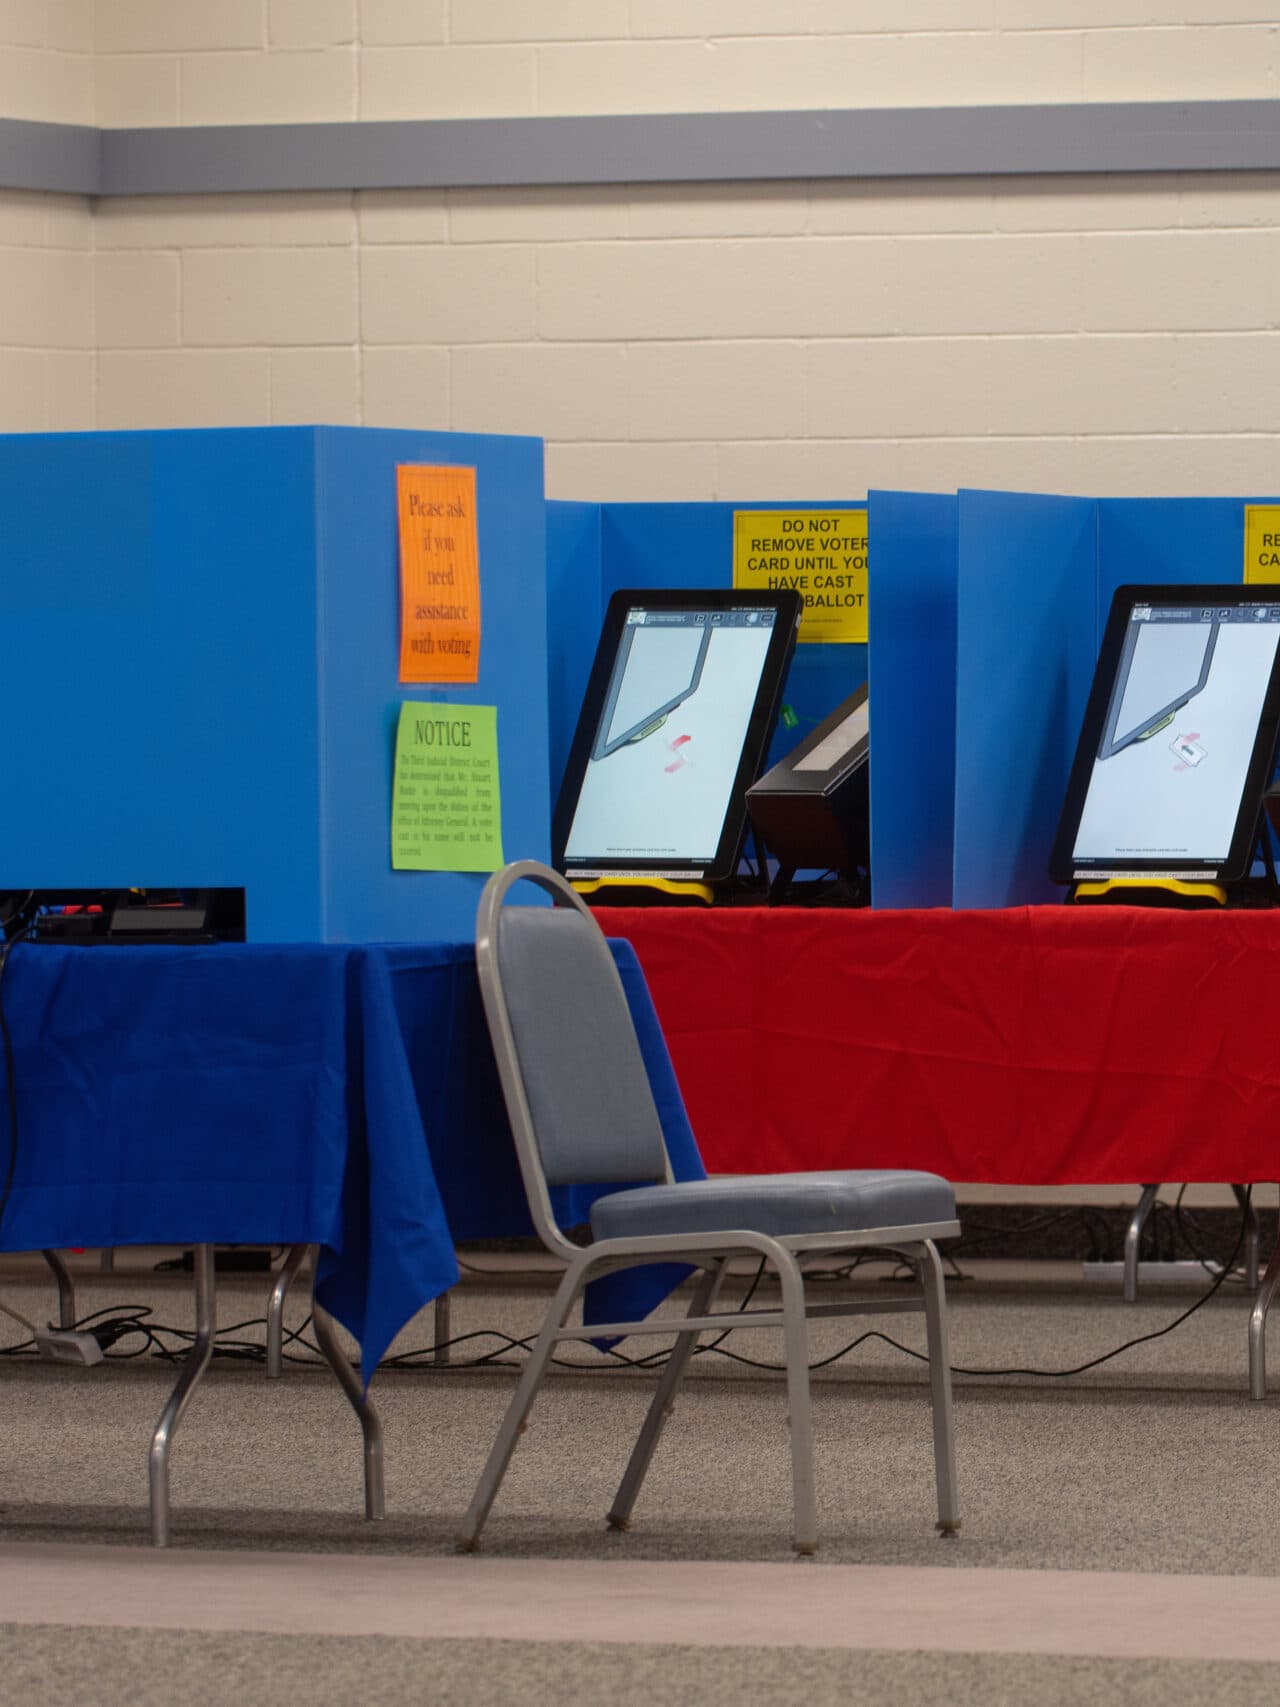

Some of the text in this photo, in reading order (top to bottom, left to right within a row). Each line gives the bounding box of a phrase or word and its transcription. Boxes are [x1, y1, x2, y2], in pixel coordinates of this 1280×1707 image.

[408, 494, 466, 518] Please ask
[782, 519, 840, 533] DO NOT
[424, 529, 455, 557] if you
[751, 538, 815, 552] REMOVE
[747, 556, 868, 571] CARD UNTIL YO
[428, 564, 455, 586] need
[768, 575, 854, 590] HAVE CAST
[415, 599, 469, 621] assistance
[804, 594, 864, 608] BALLOT
[411, 632, 471, 657] with voting
[415, 720, 471, 747] NOTICE
